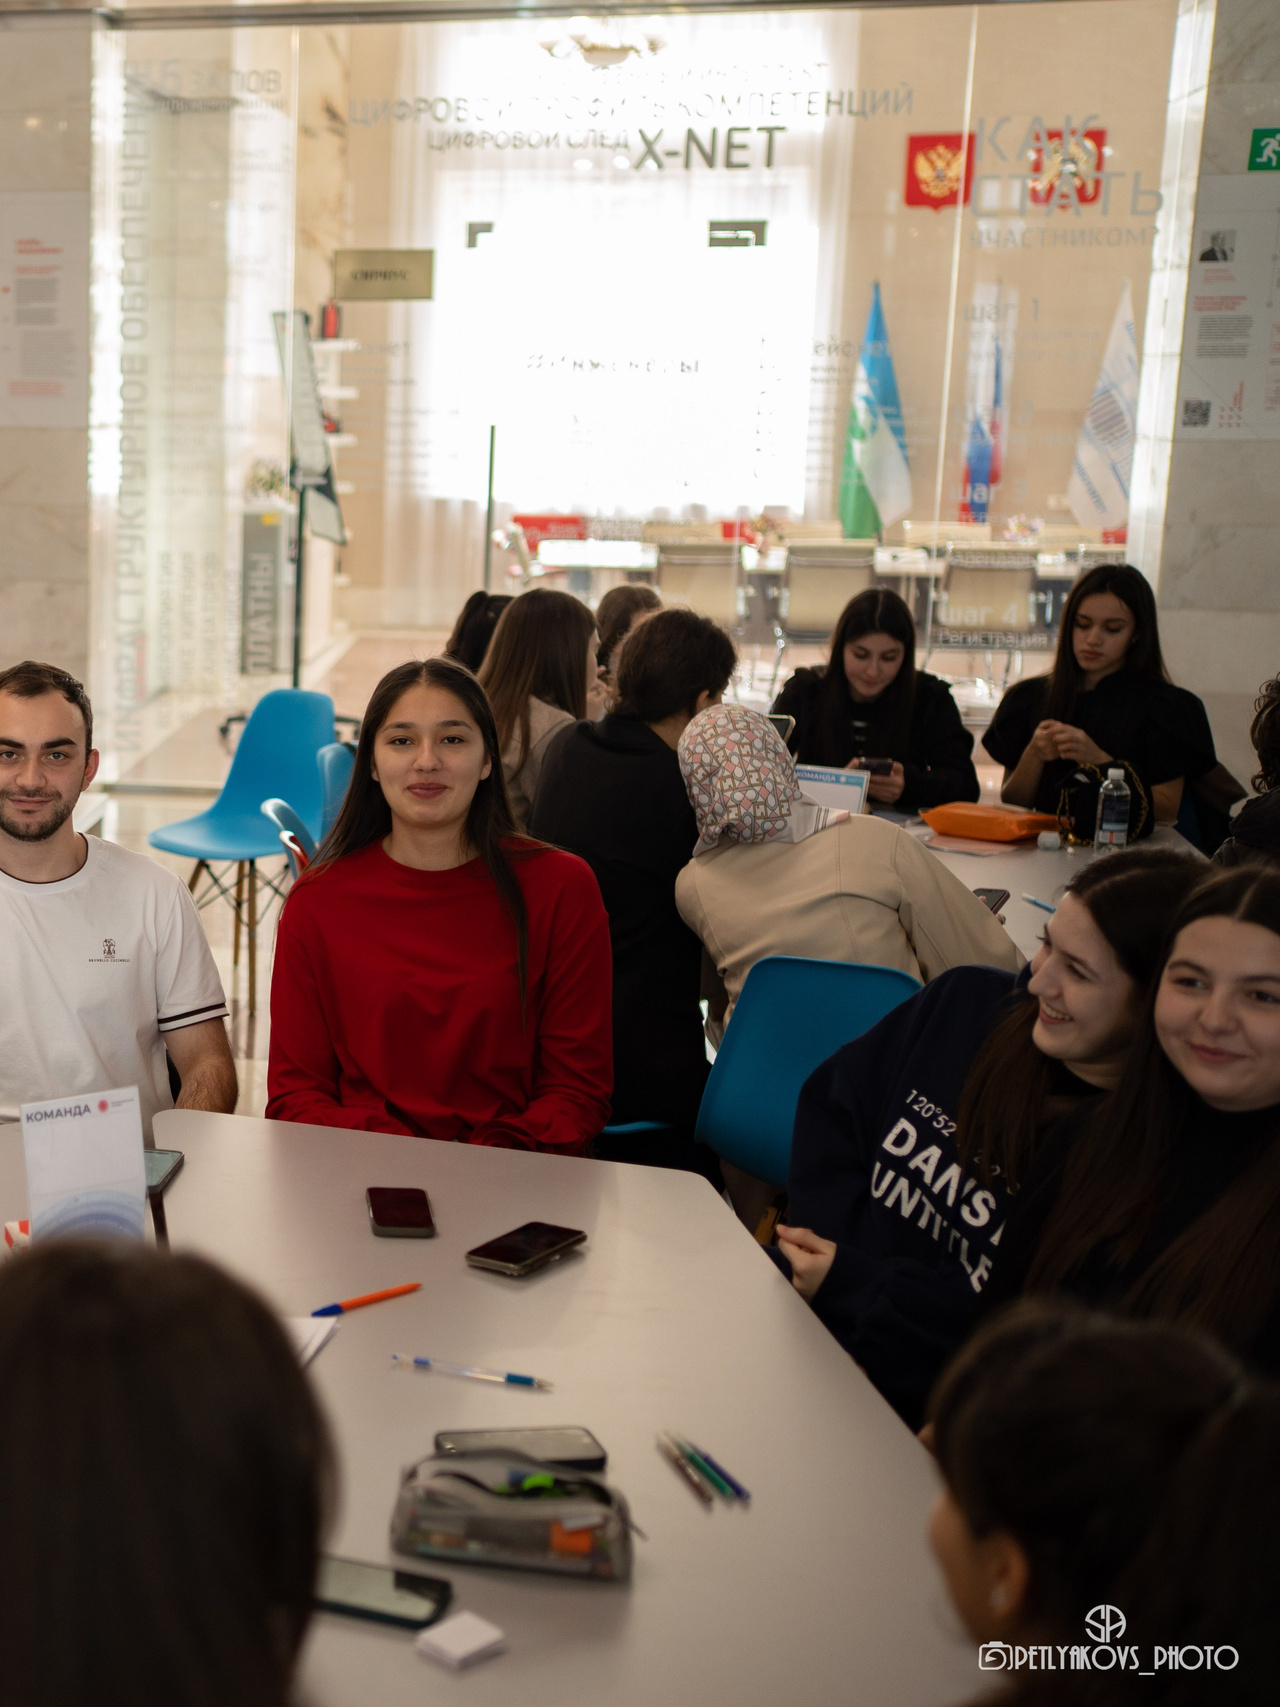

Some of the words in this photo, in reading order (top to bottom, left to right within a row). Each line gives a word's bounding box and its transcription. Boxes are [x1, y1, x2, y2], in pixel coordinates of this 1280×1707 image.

[631, 126, 788, 172] X-NET
[976, 114, 1101, 163] КАК
[970, 170, 1165, 218] СТАТЬ
[969, 225, 1161, 249] УЧАСТНИКОМ?
[938, 605, 991, 627] шаг
[1002, 602, 1019, 627] 4
[25, 1103, 92, 1123] КОМАНДА
